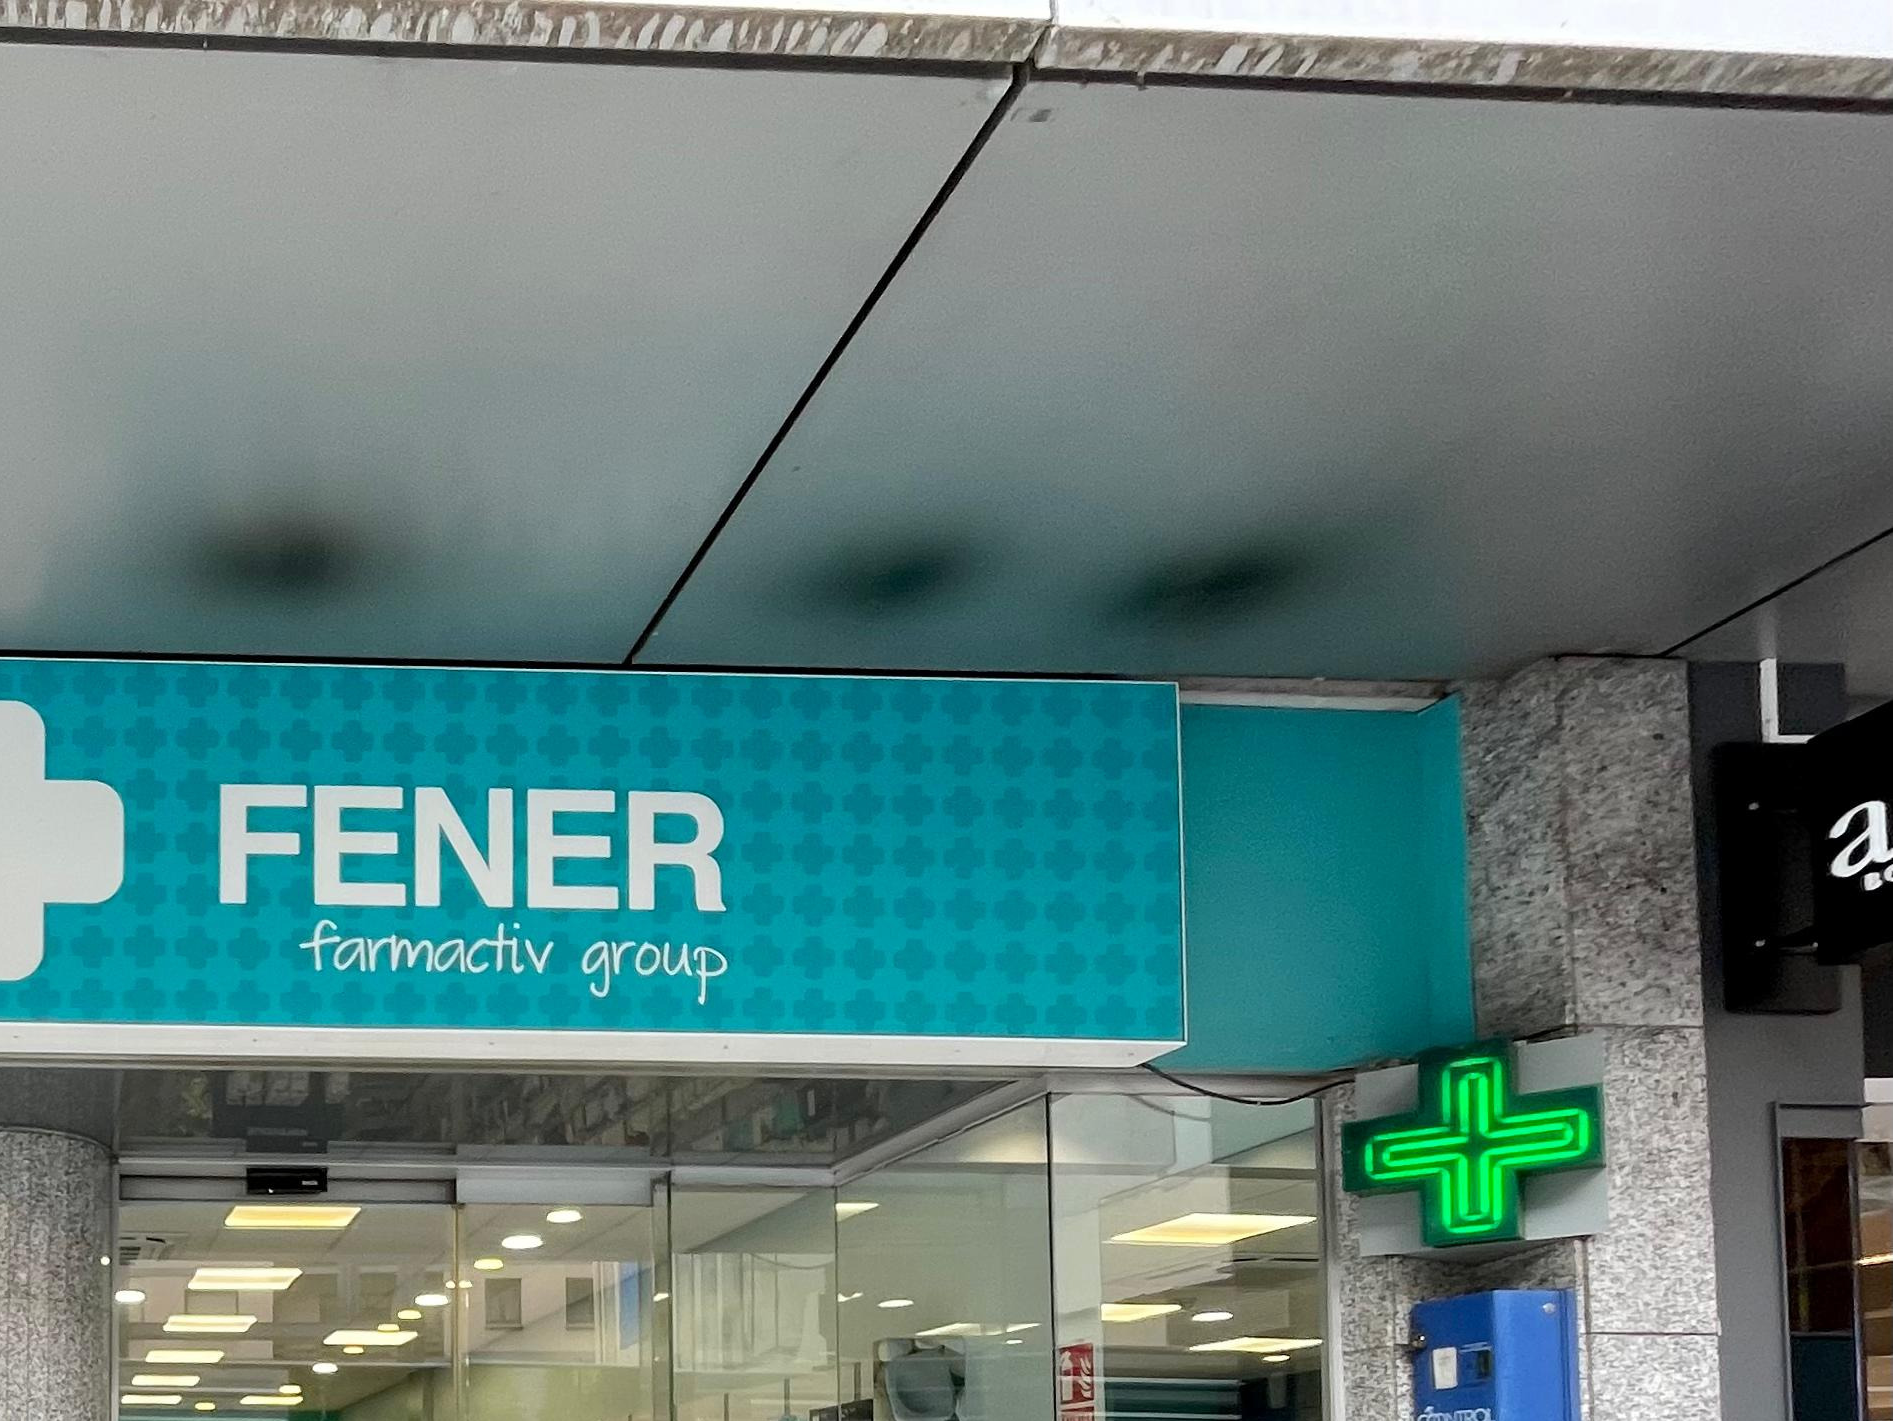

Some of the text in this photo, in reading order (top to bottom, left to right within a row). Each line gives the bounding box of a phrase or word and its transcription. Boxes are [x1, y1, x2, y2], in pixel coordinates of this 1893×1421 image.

[218, 783, 727, 912] FENER
[299, 918, 729, 1005] farmactiv group
